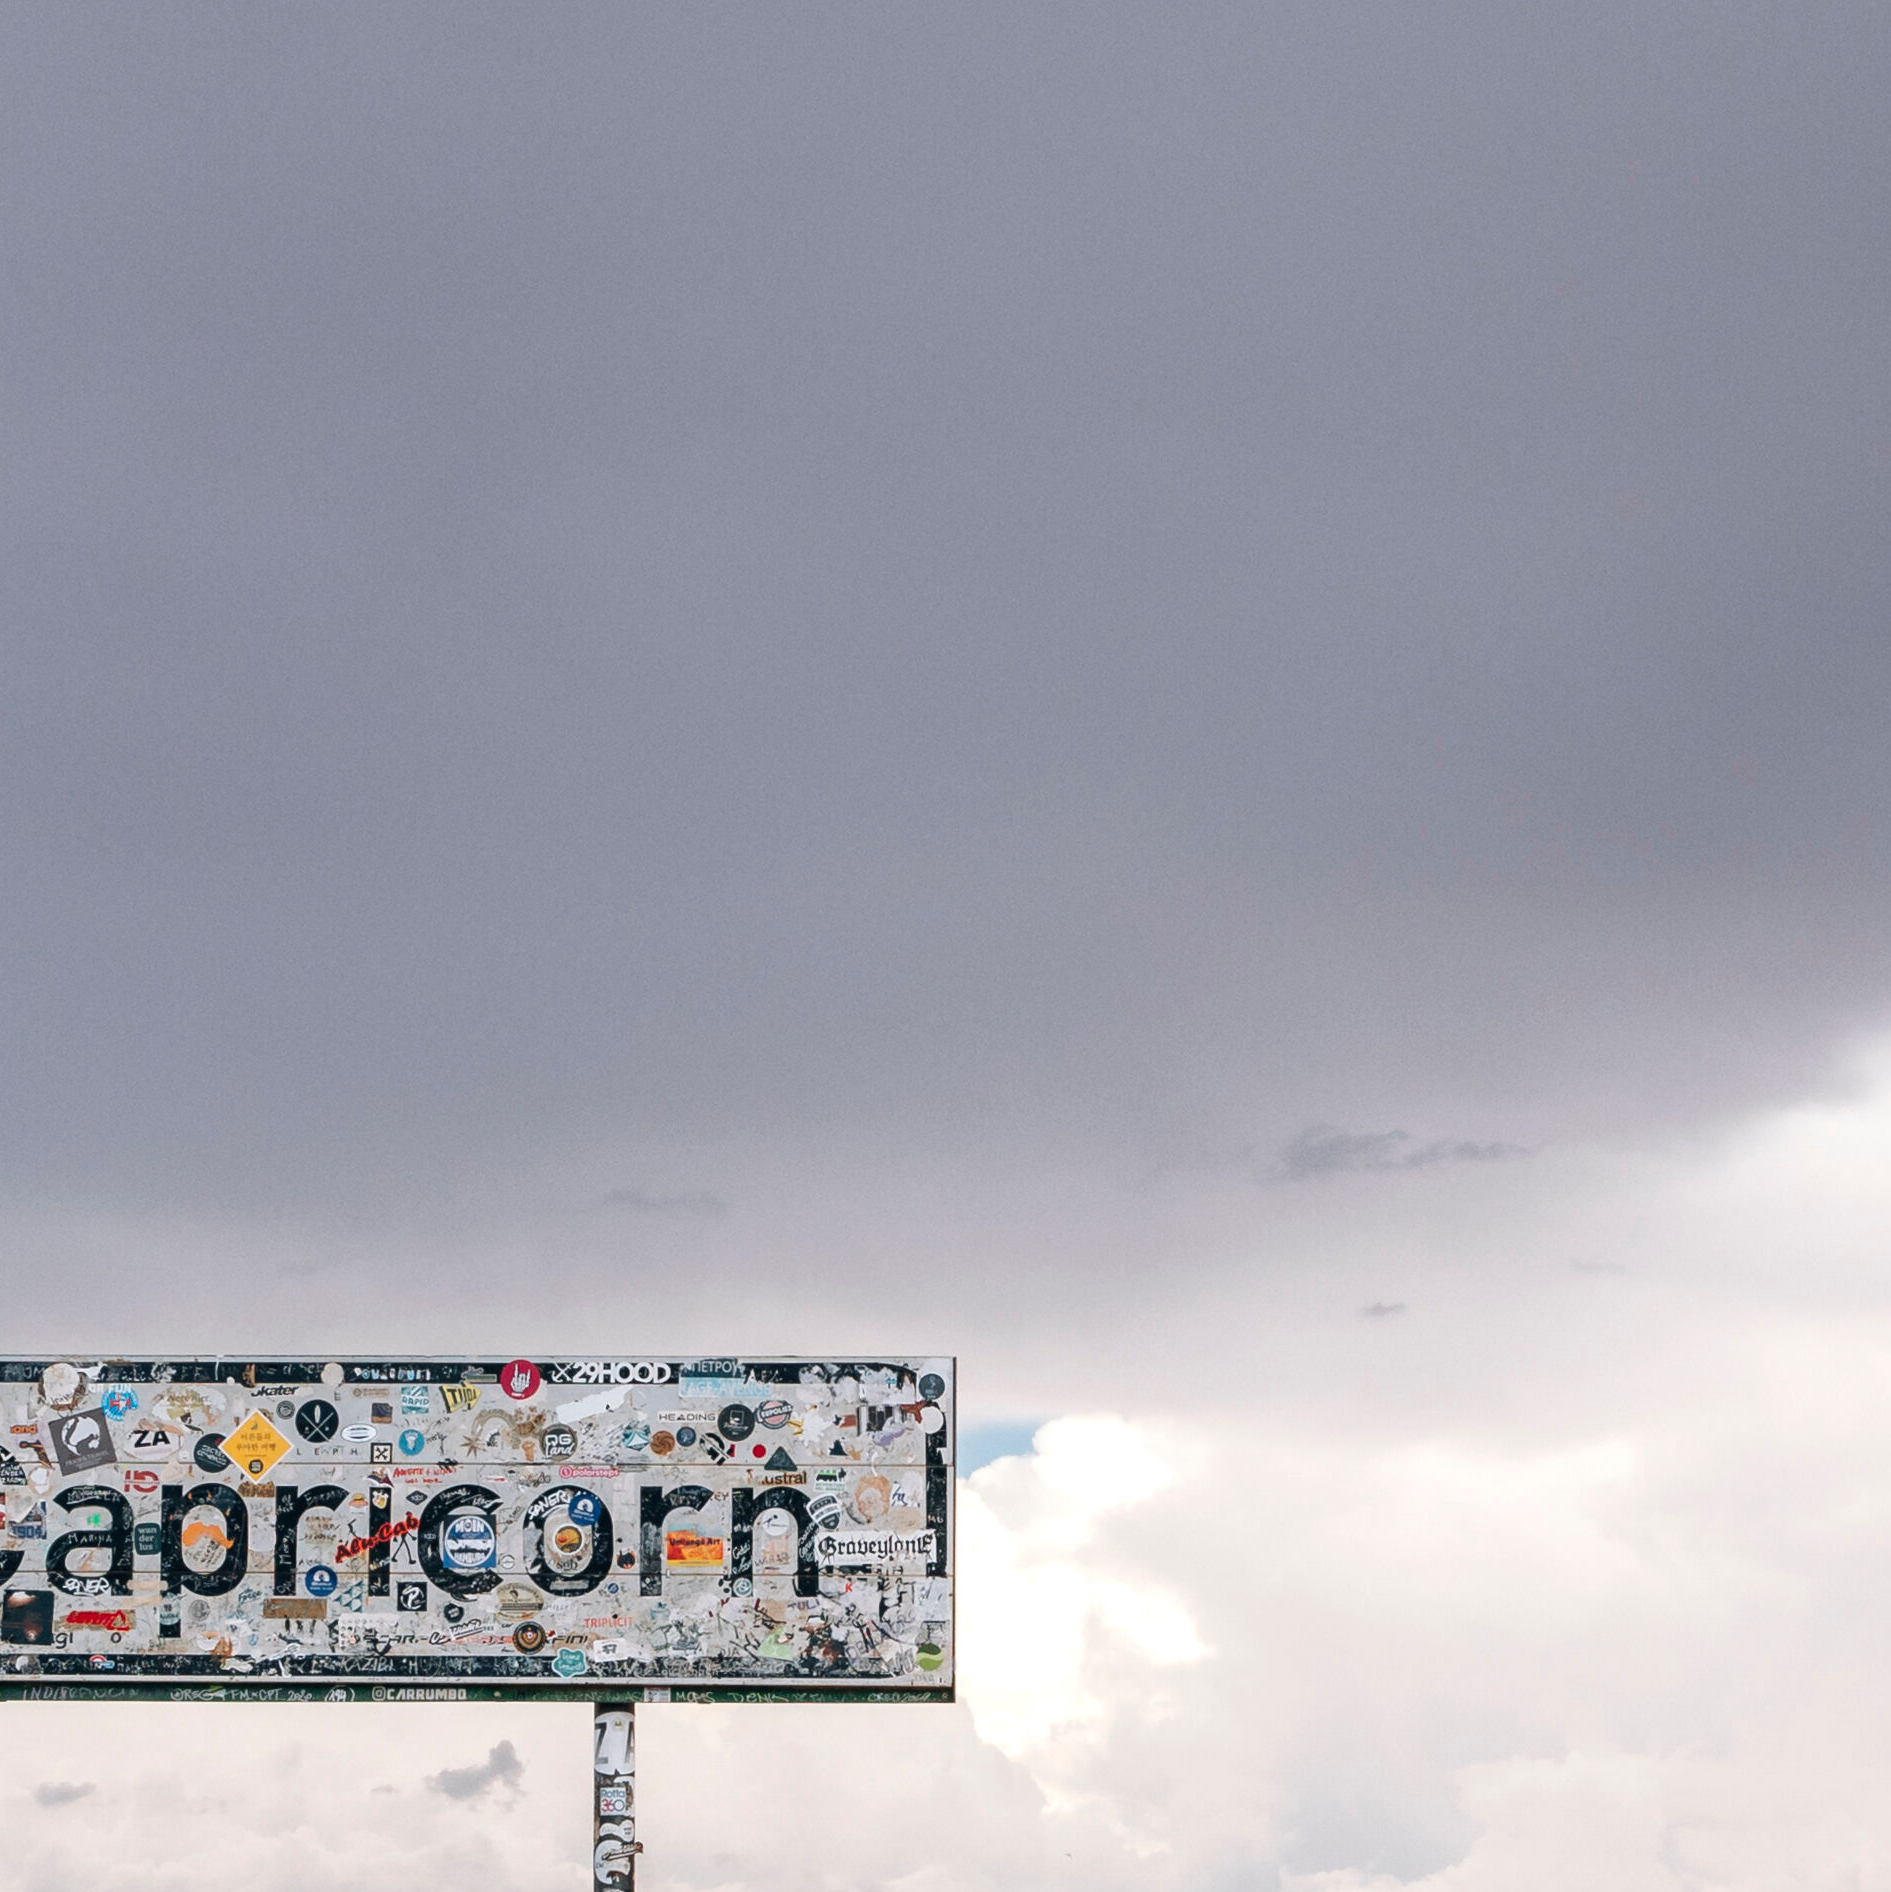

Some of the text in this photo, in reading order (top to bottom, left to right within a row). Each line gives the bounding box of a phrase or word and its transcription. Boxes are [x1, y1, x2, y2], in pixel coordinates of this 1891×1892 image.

[573, 1362, 671, 1383] 29HOOD
[659, 1413, 716, 1421] HEADING
[134, 1430, 170, 1448] ZA
[455, 1520, 485, 1533] MOIN
[138, 1534, 154, 1543] der
[387, 1688, 468, 1701] CARRUMBO
[600, 1788, 626, 1799] Rotta
[601, 1799, 626, 1812] 360
